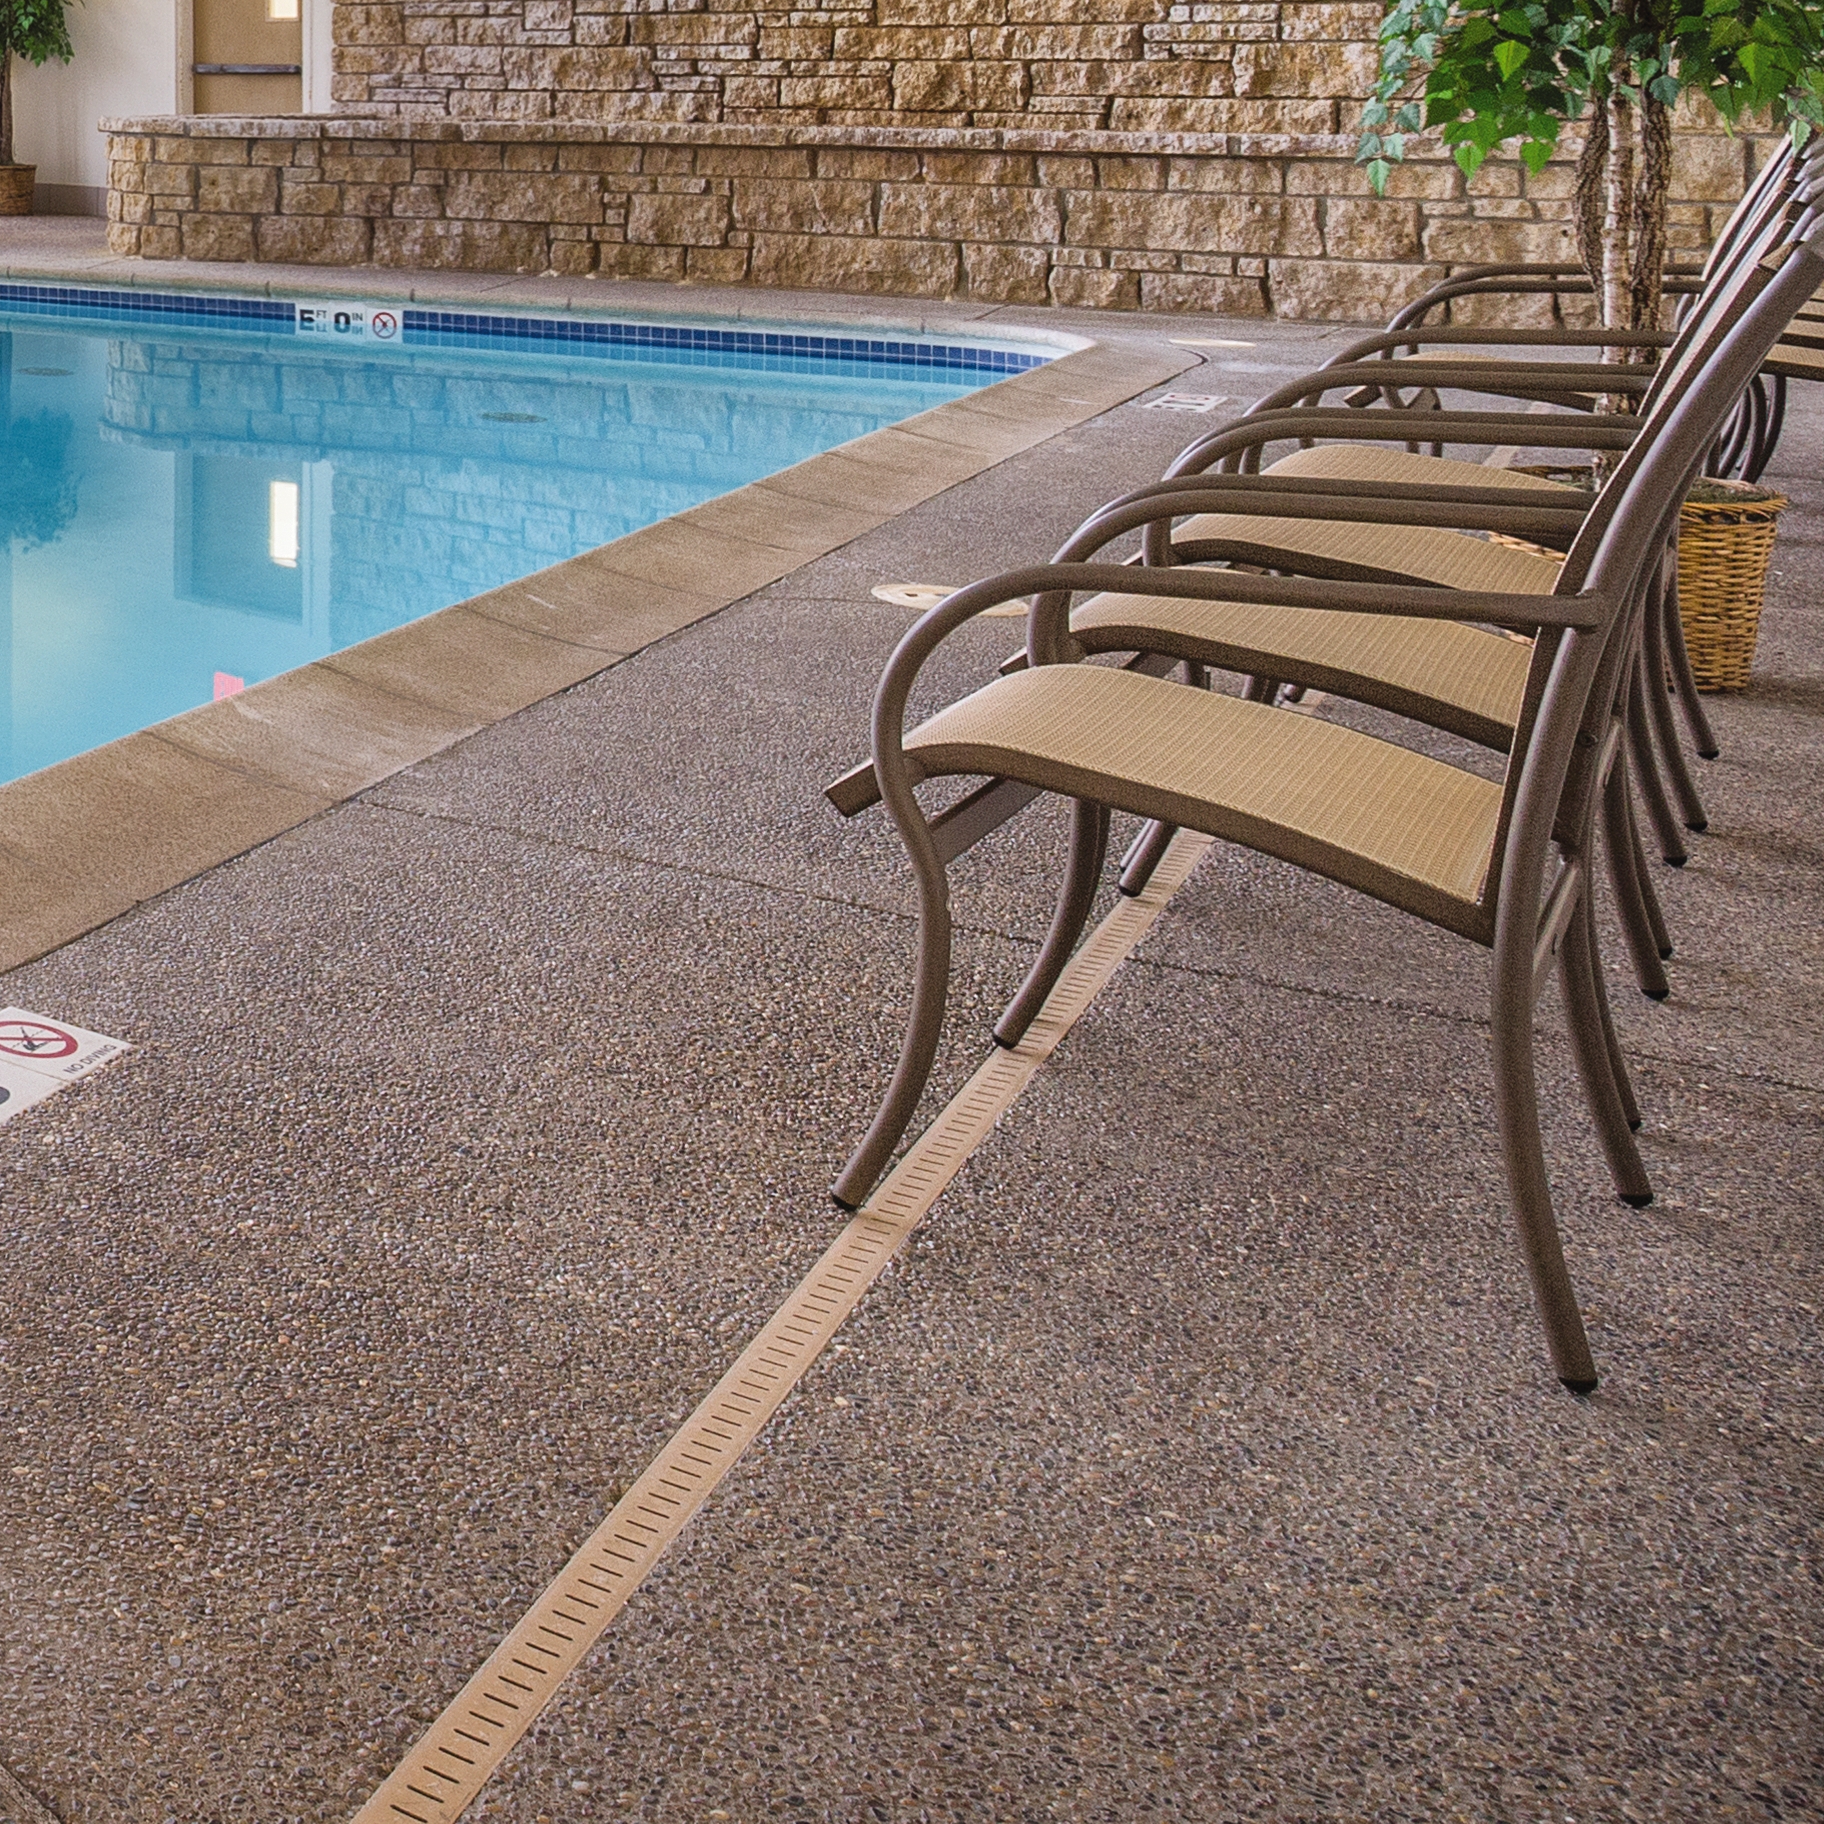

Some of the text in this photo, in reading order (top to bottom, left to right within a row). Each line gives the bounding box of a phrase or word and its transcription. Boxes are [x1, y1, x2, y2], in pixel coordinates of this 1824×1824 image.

[316, 309, 327, 319] FT
[352, 312, 363, 322] IN
[63, 1044, 117, 1074] NO DIVING
